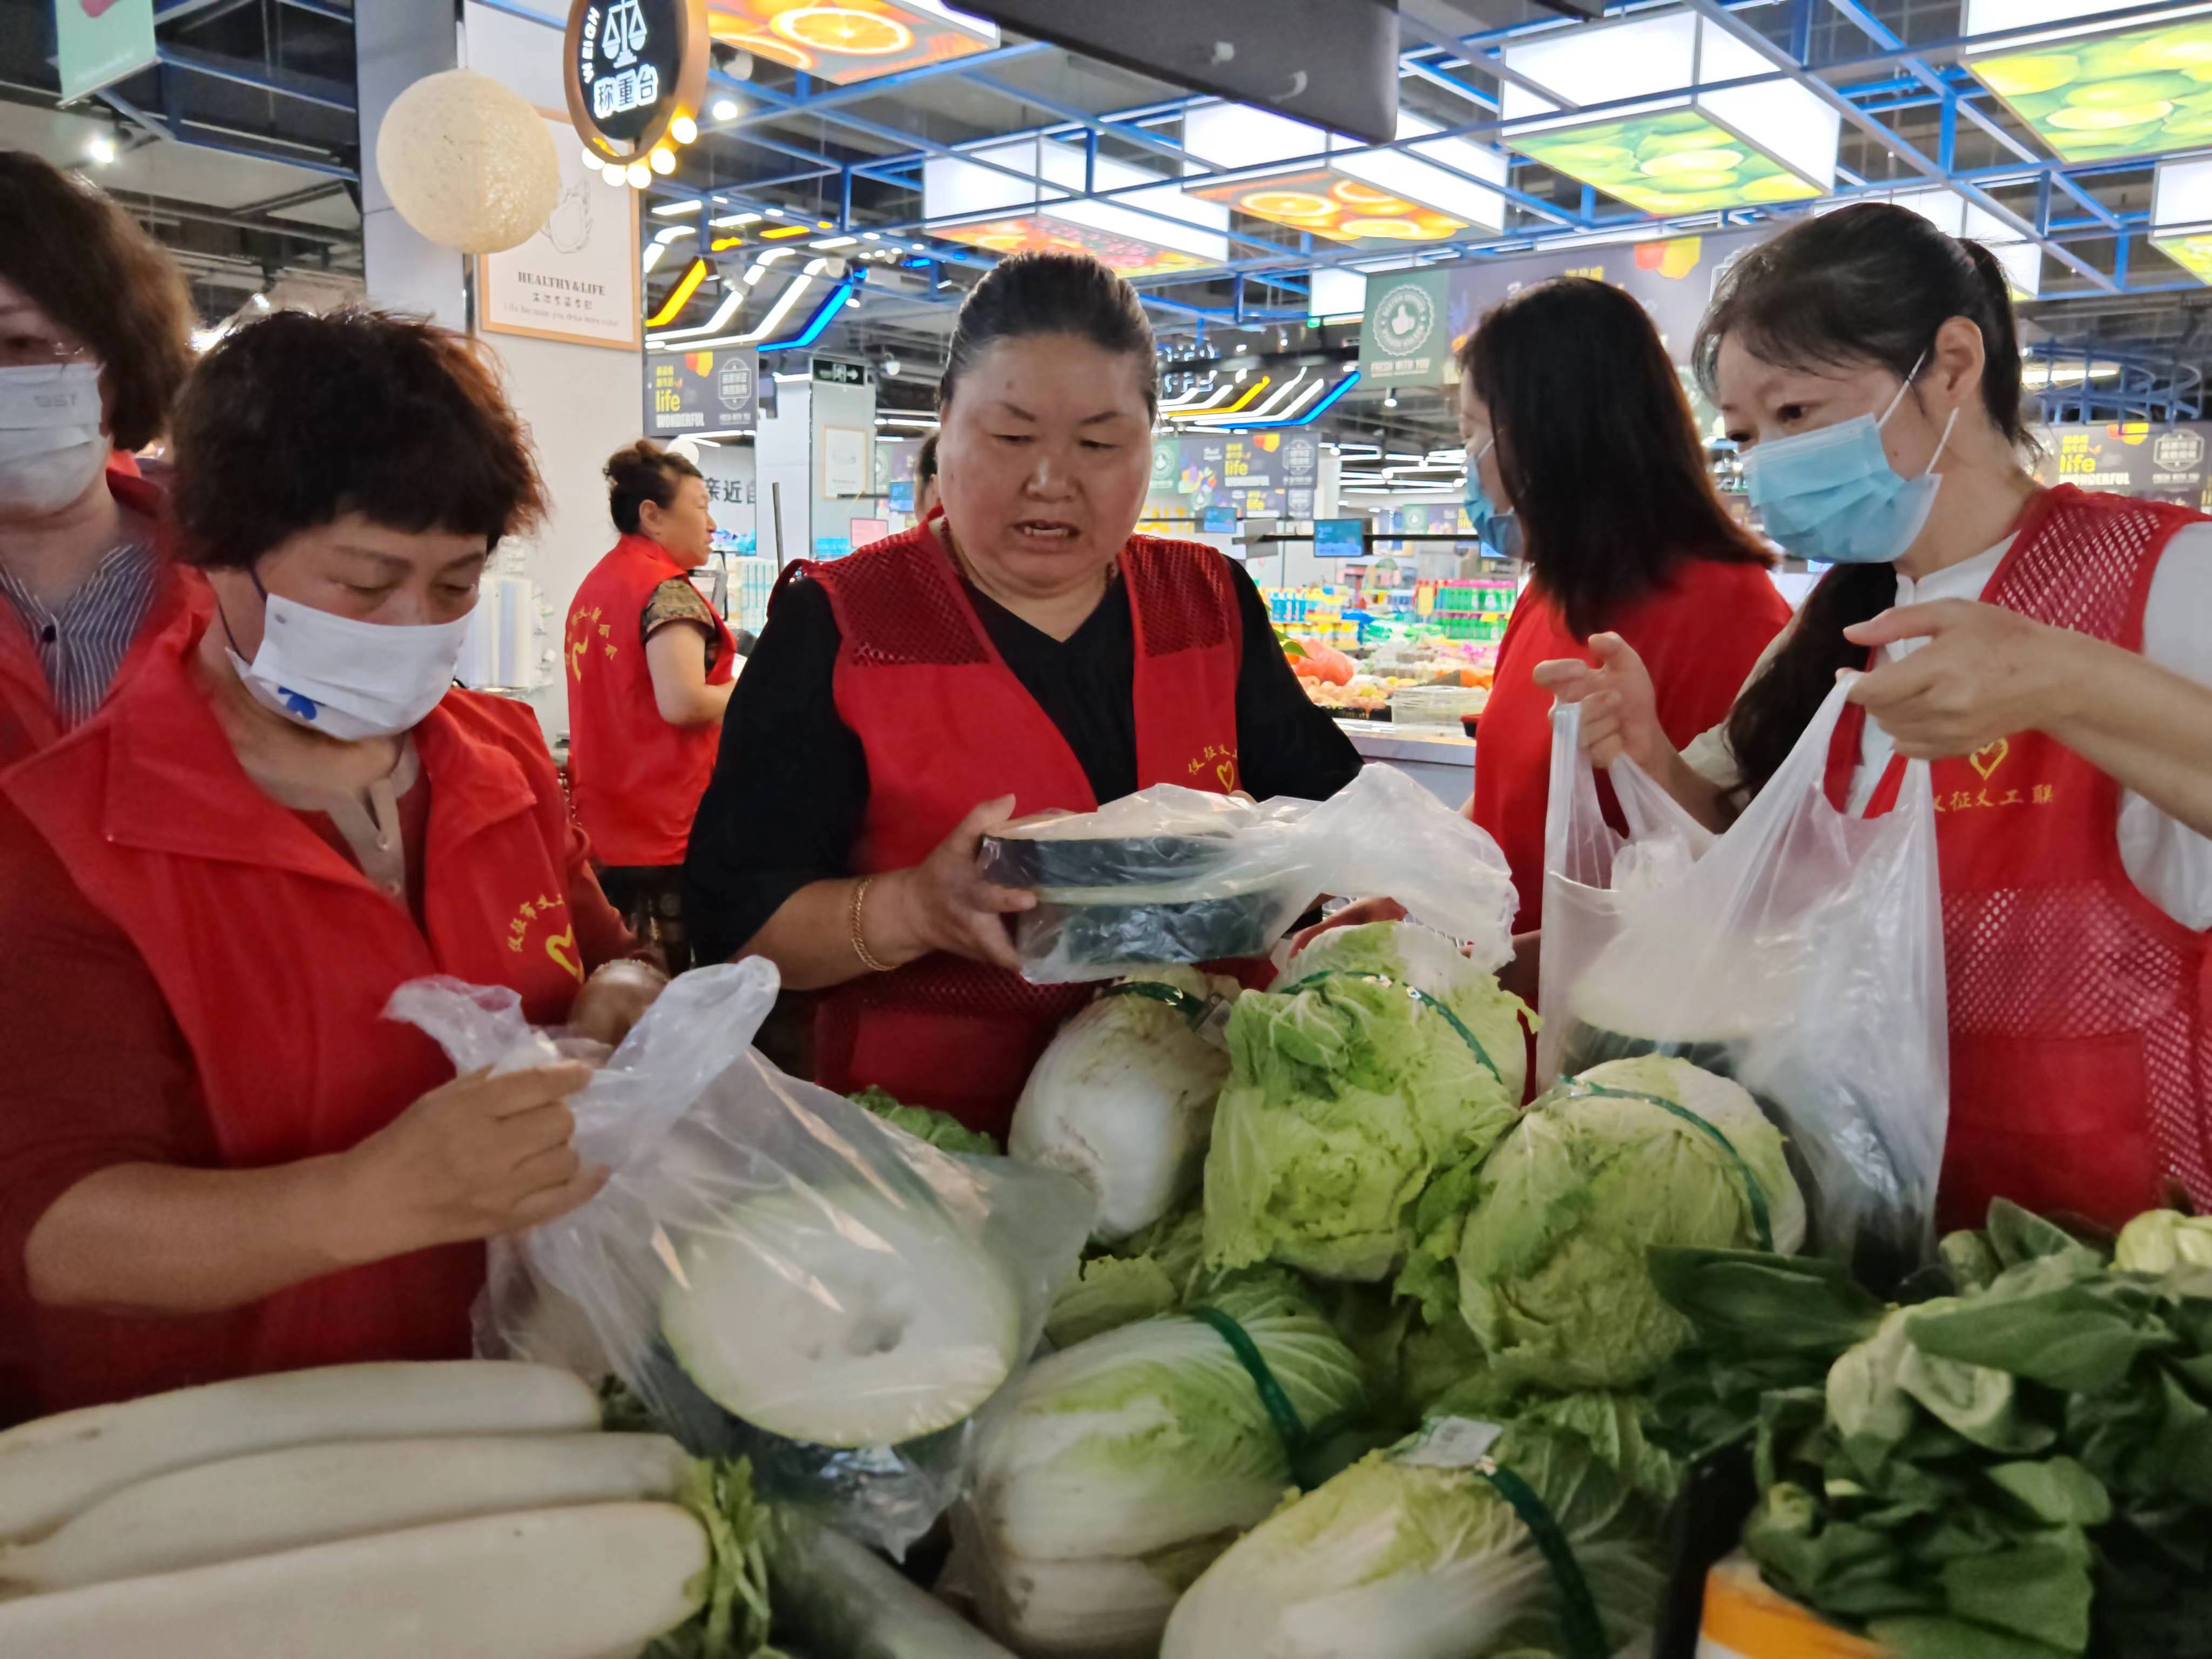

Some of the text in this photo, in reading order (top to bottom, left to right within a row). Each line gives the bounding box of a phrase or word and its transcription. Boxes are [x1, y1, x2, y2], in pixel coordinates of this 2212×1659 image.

[582, 6, 601, 84] WEIGH
[596, 65, 657, 116] 称重台
[518, 272, 605, 296] HEALTHY&LIFE
[656, 389, 680, 412] life
[656, 412, 705, 428] WONDERFUL
[1225, 459, 1248, 476] life
[2059, 454, 2096, 473] life
